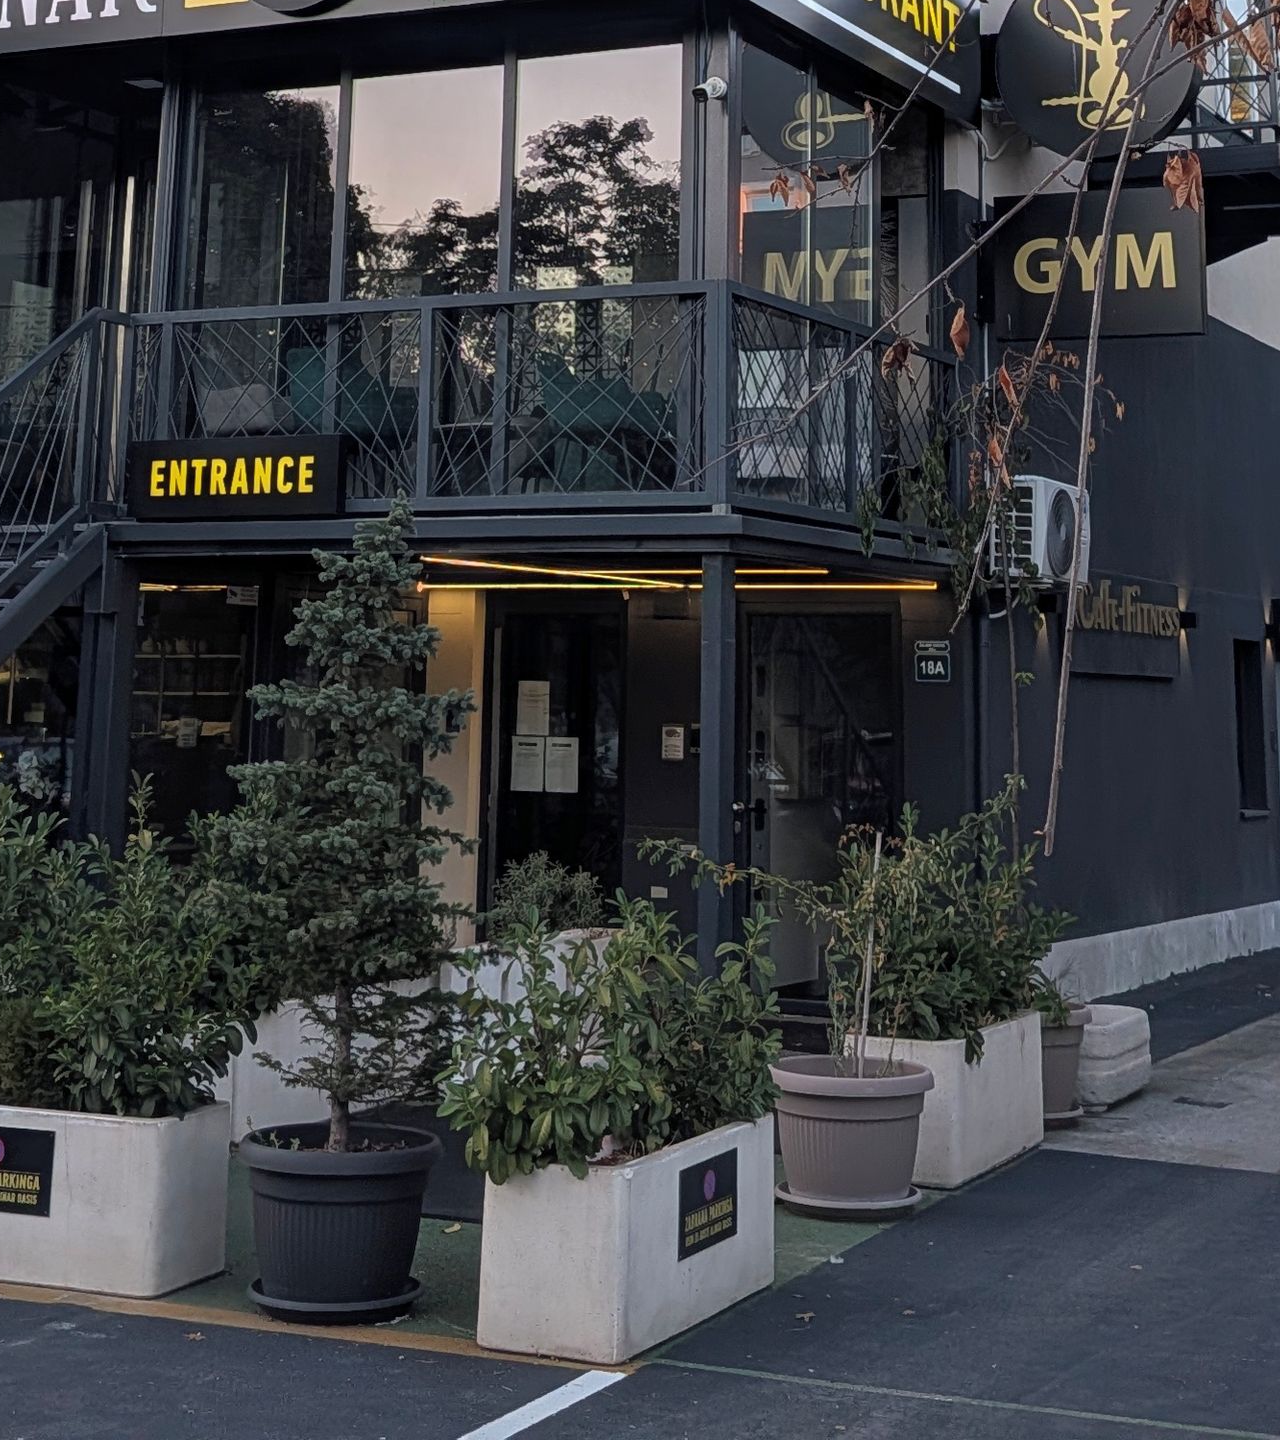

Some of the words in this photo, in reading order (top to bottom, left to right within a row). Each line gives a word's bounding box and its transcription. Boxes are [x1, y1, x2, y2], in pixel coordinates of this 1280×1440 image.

[1013, 231, 1178, 295] GYM
[149, 455, 315, 498] ENTRANCE
[919, 660, 945, 675] 18A
